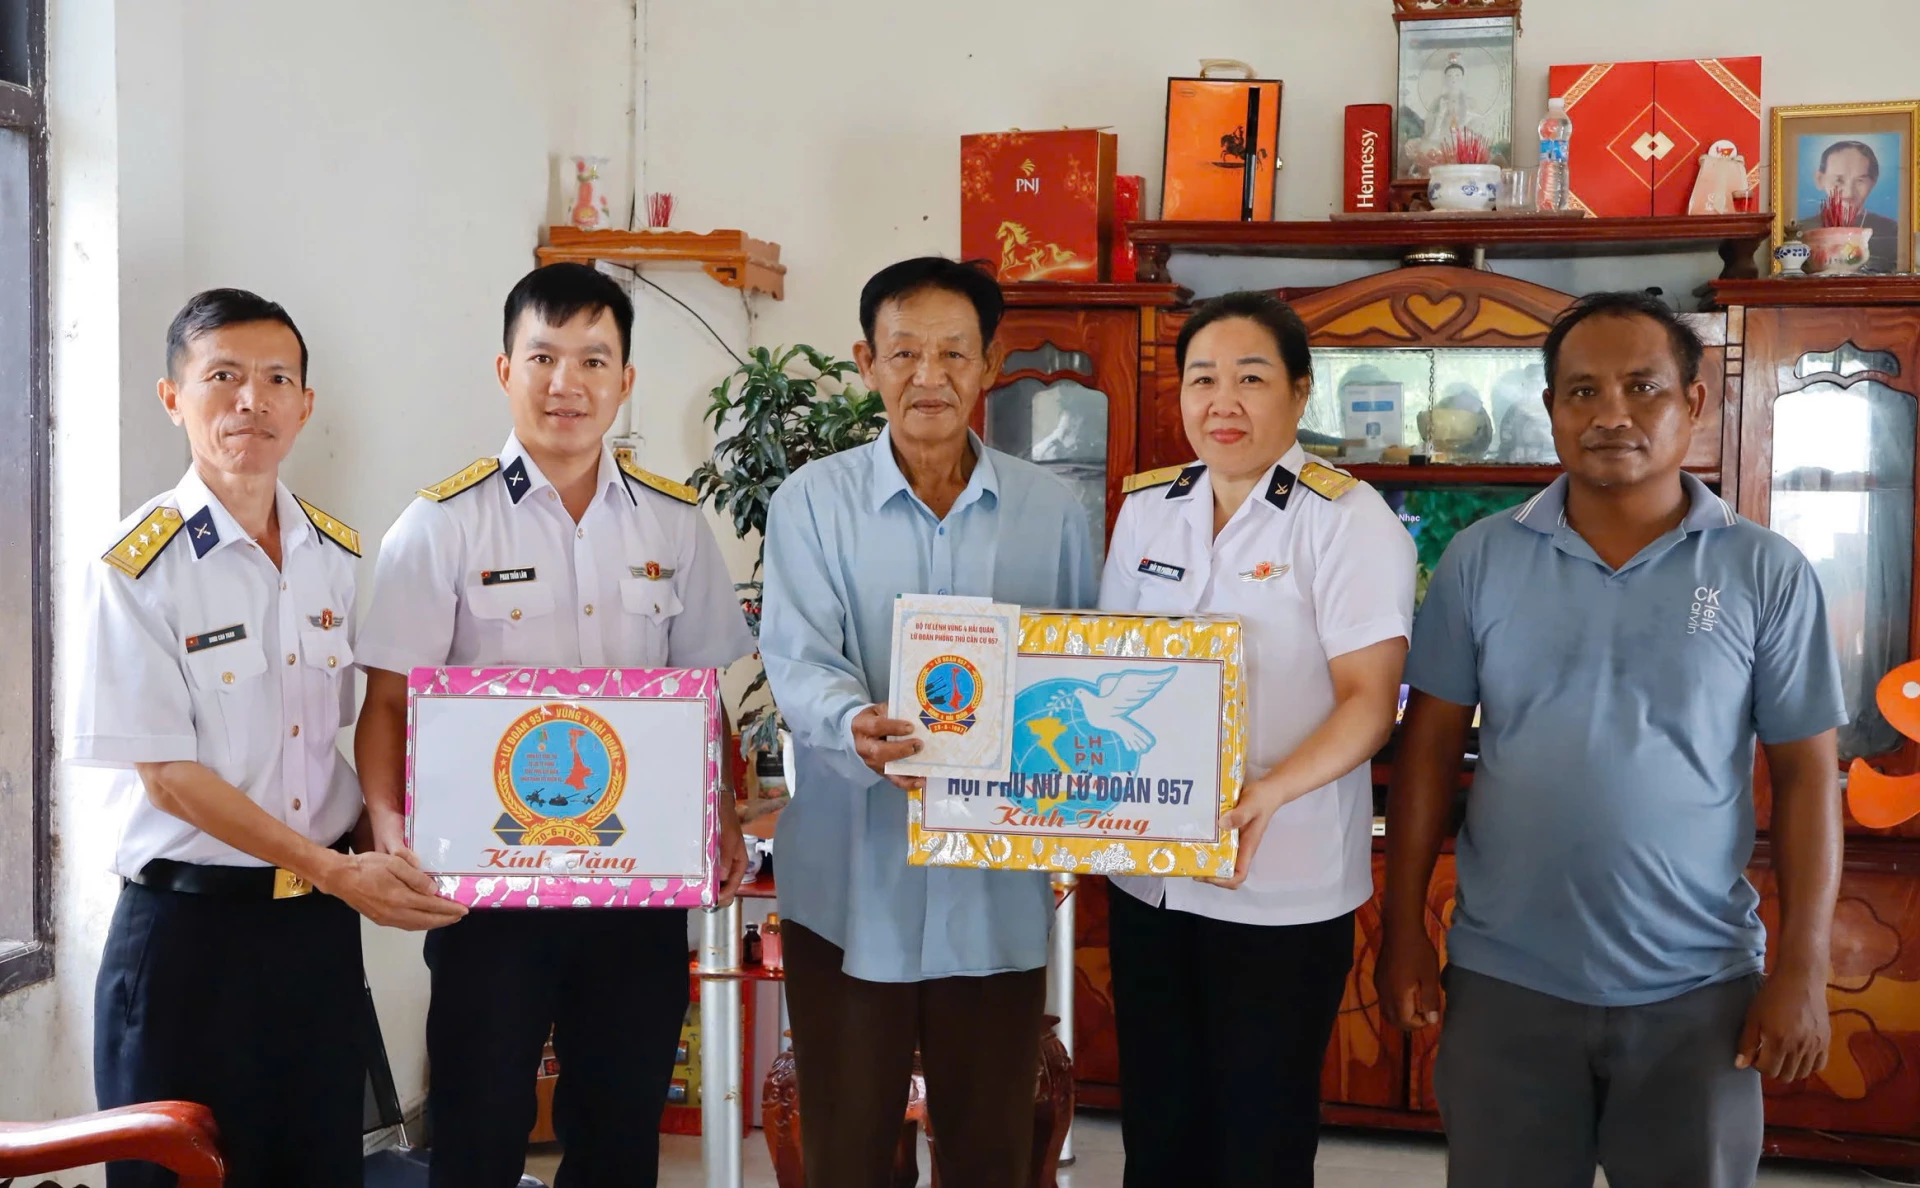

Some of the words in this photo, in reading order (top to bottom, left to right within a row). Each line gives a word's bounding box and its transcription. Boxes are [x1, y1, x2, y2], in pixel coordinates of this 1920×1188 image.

[1357, 128, 1378, 208] Hennessy
[1016, 178, 1040, 194] PNJ
[1399, 513, 1421, 523] Nhạc
[583, 715, 590, 725] 4
[1033, 768, 1062, 800] NỮ
[1067, 769, 1092, 801] LỮ
[1096, 771, 1150, 804] ĐOÀN
[1157, 778, 1194, 805] 957
[989, 805, 1066, 828] Kính
[1076, 810, 1150, 835] Tặng
